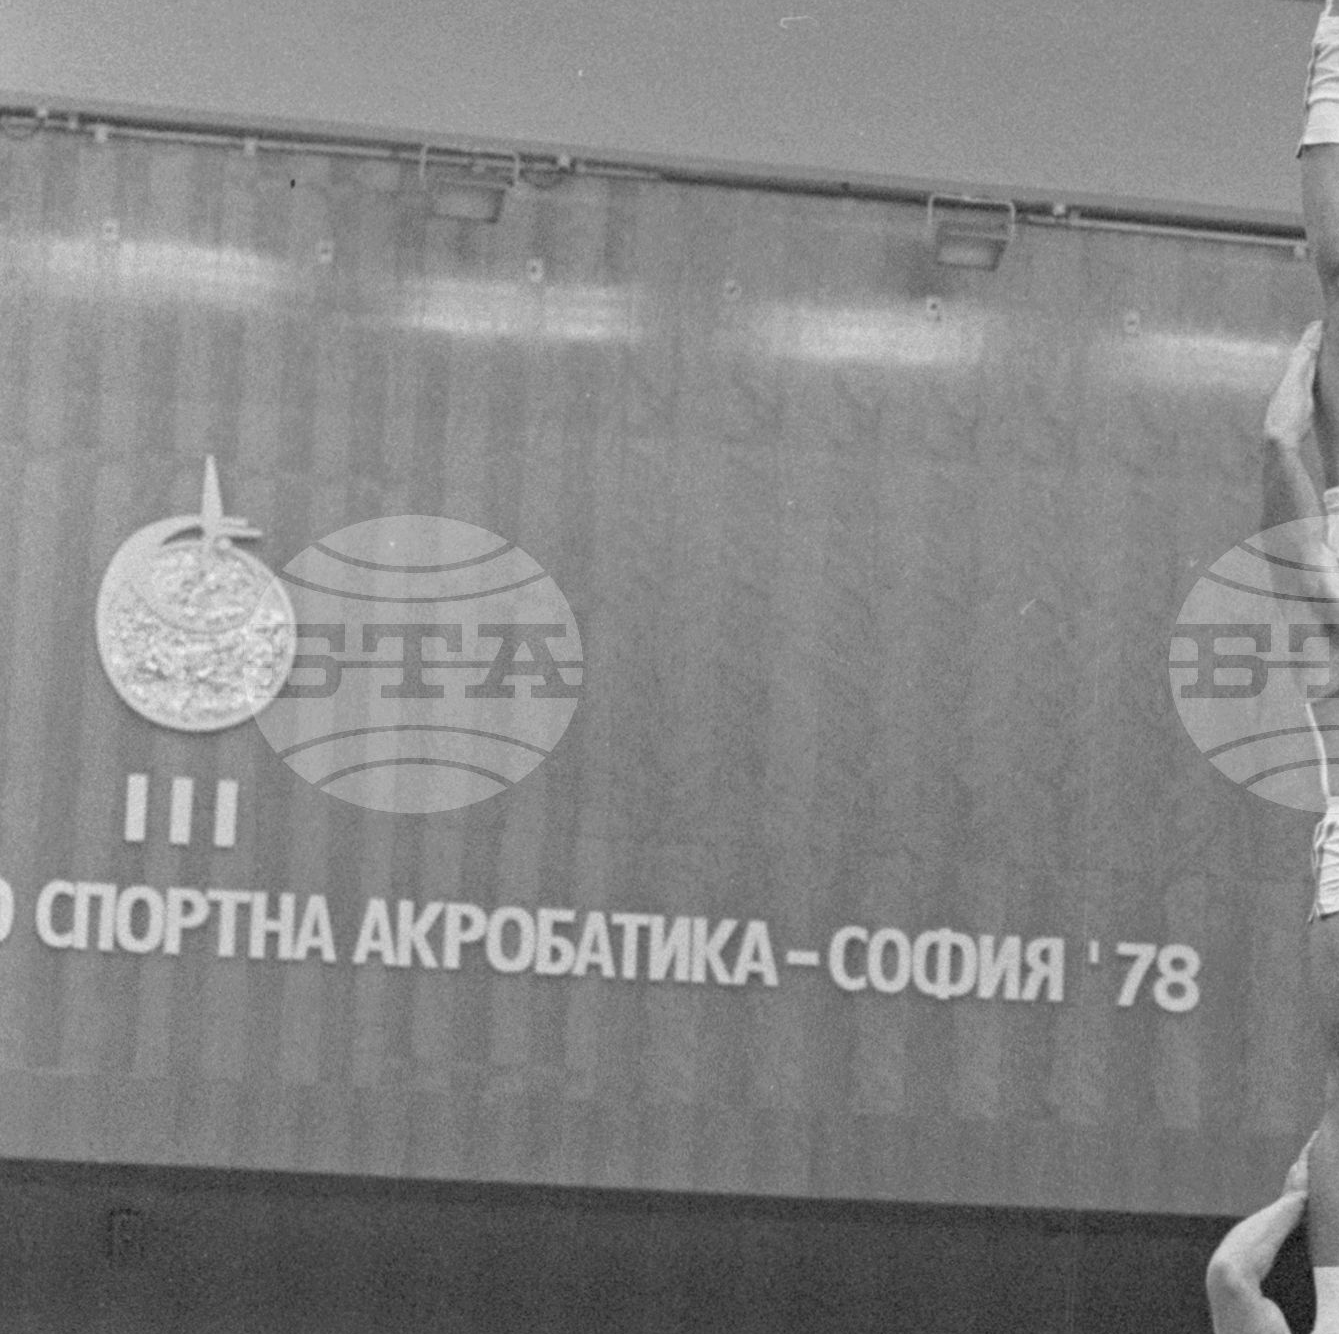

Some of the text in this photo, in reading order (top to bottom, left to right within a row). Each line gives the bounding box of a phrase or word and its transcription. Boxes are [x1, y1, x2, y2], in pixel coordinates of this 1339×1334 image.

[124, 772, 239, 849] III
[35, 878, 337, 964] СПОРТНА
[1087, 939, 1202, 1012] '78
